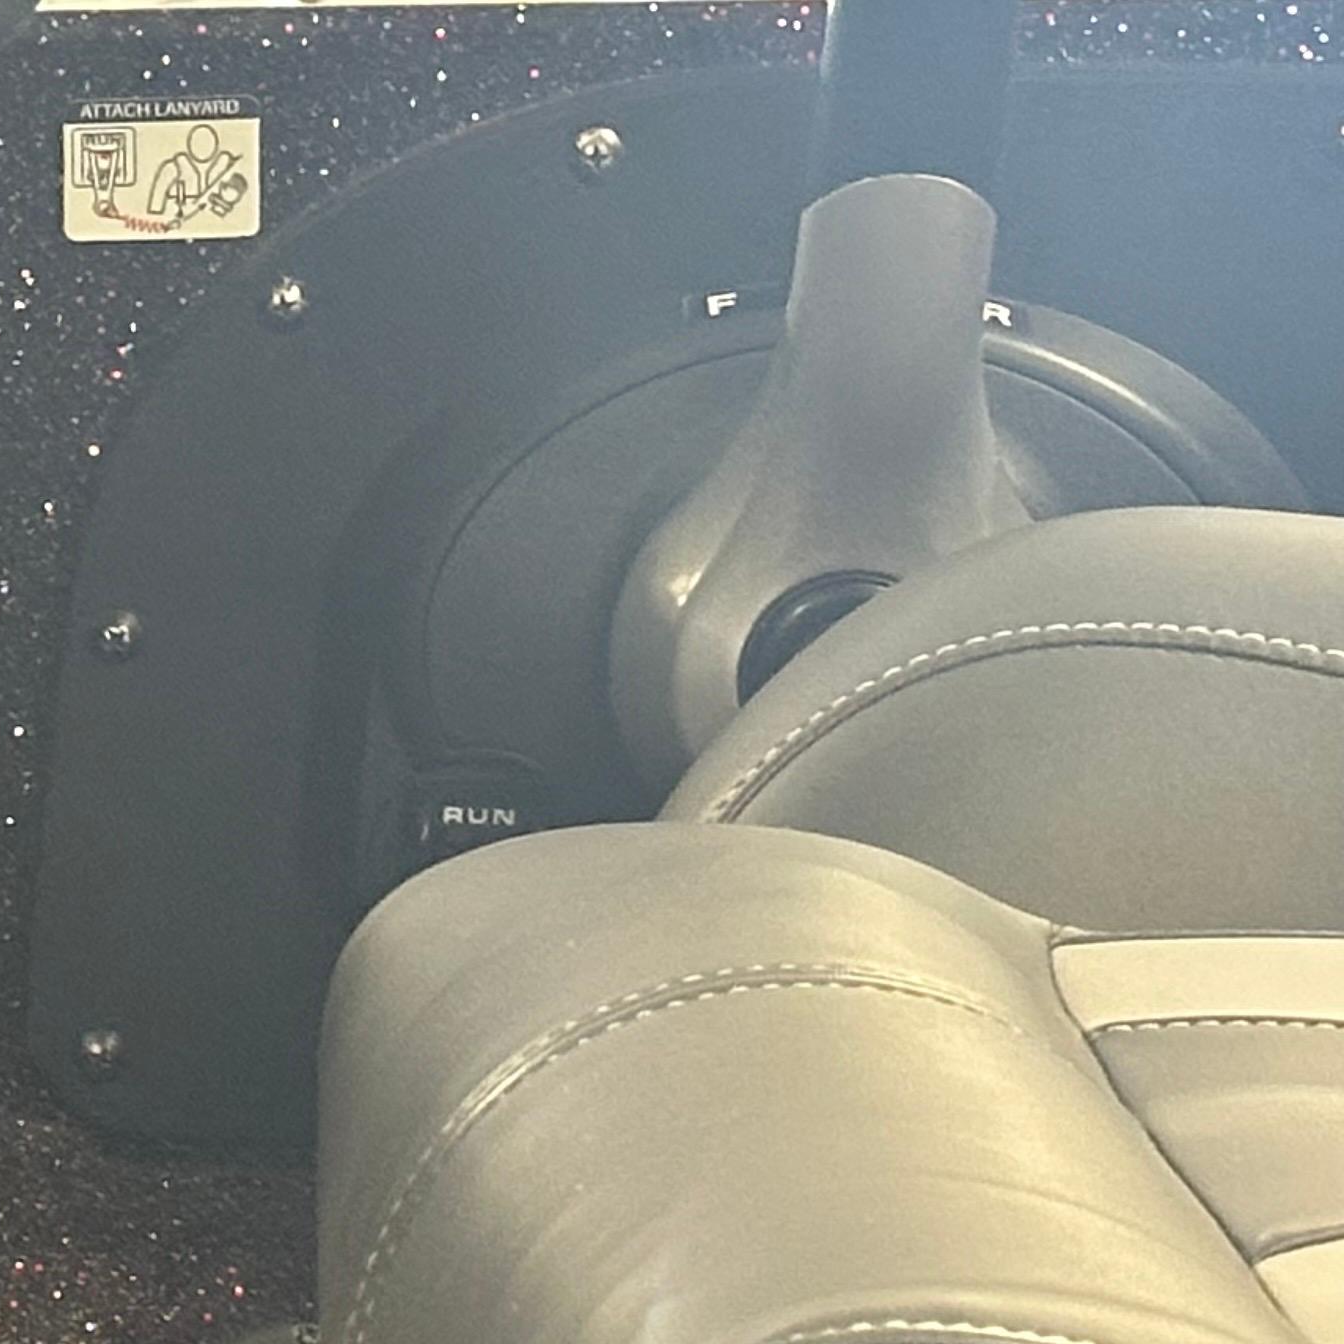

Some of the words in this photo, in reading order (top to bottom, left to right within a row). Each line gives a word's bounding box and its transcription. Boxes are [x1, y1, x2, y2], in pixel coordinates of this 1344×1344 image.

[80, 103, 150, 119] ATTACH
[155, 99, 240, 116] LANYARD
[707, 291, 738, 318] F
[982, 300, 1013, 328] R
[443, 806, 515, 827] RUN
